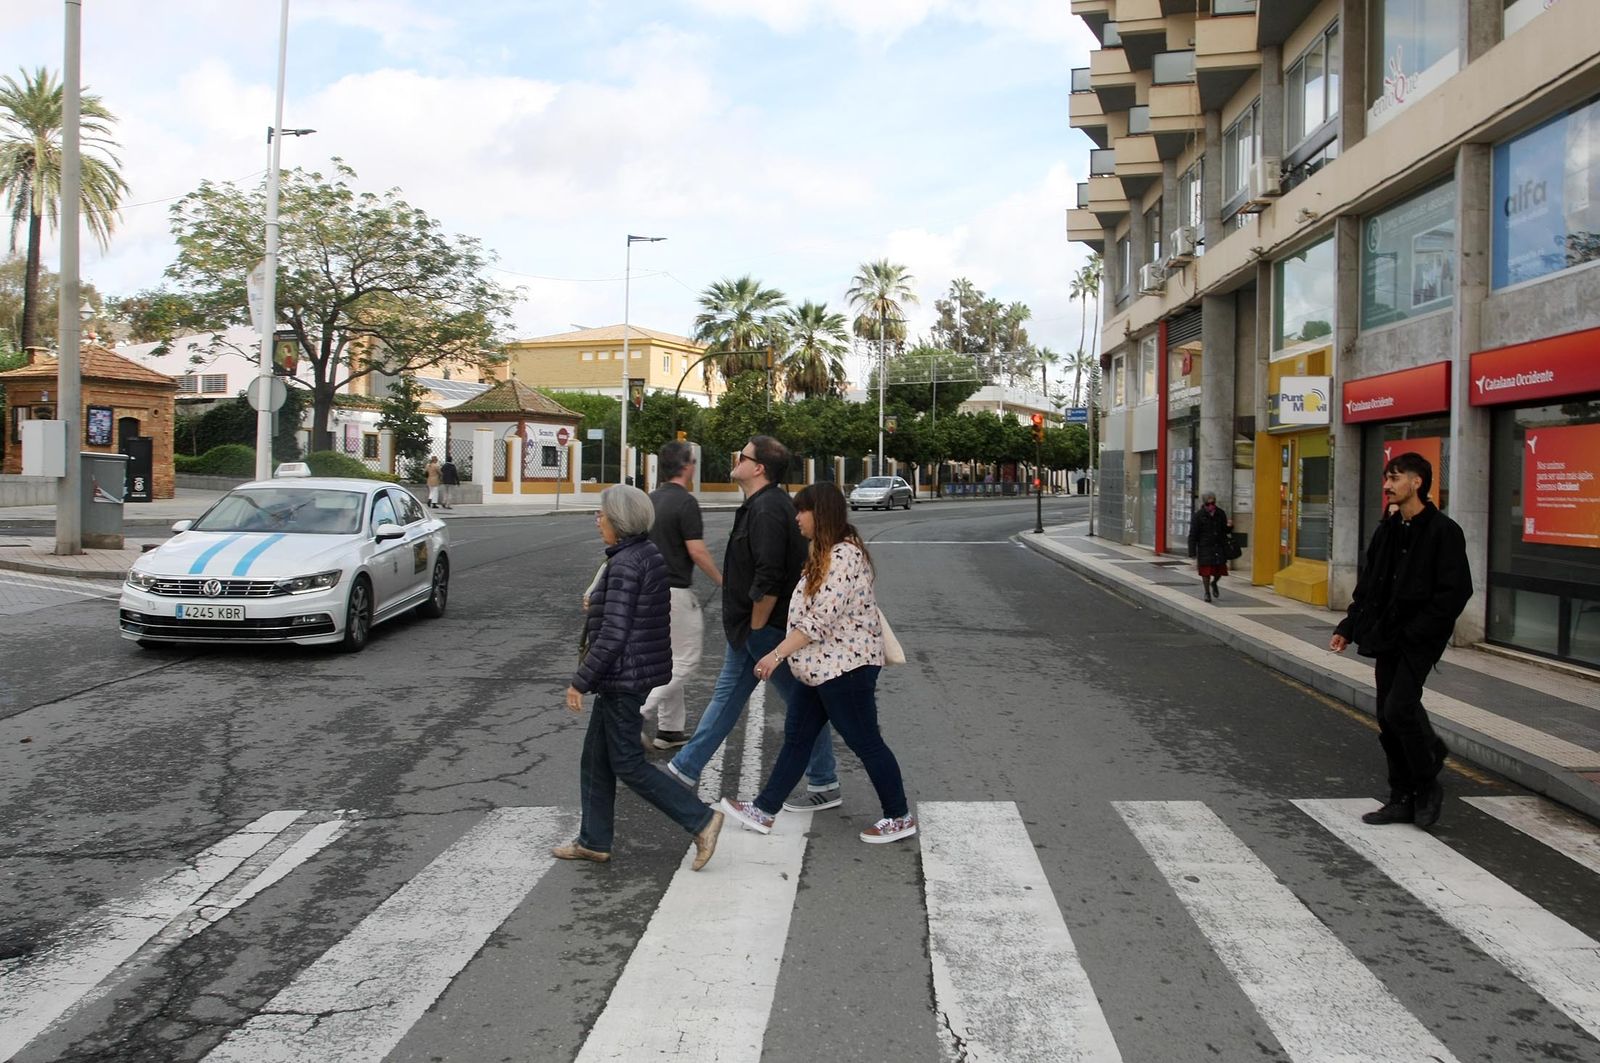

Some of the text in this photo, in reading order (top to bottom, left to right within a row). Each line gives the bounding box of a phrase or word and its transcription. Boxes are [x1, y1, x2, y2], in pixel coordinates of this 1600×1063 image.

[1504, 180, 1547, 218] alfa
[1484, 369, 1554, 391] Catalana Occidente
[185, 606, 241, 619] 4245 KBR
